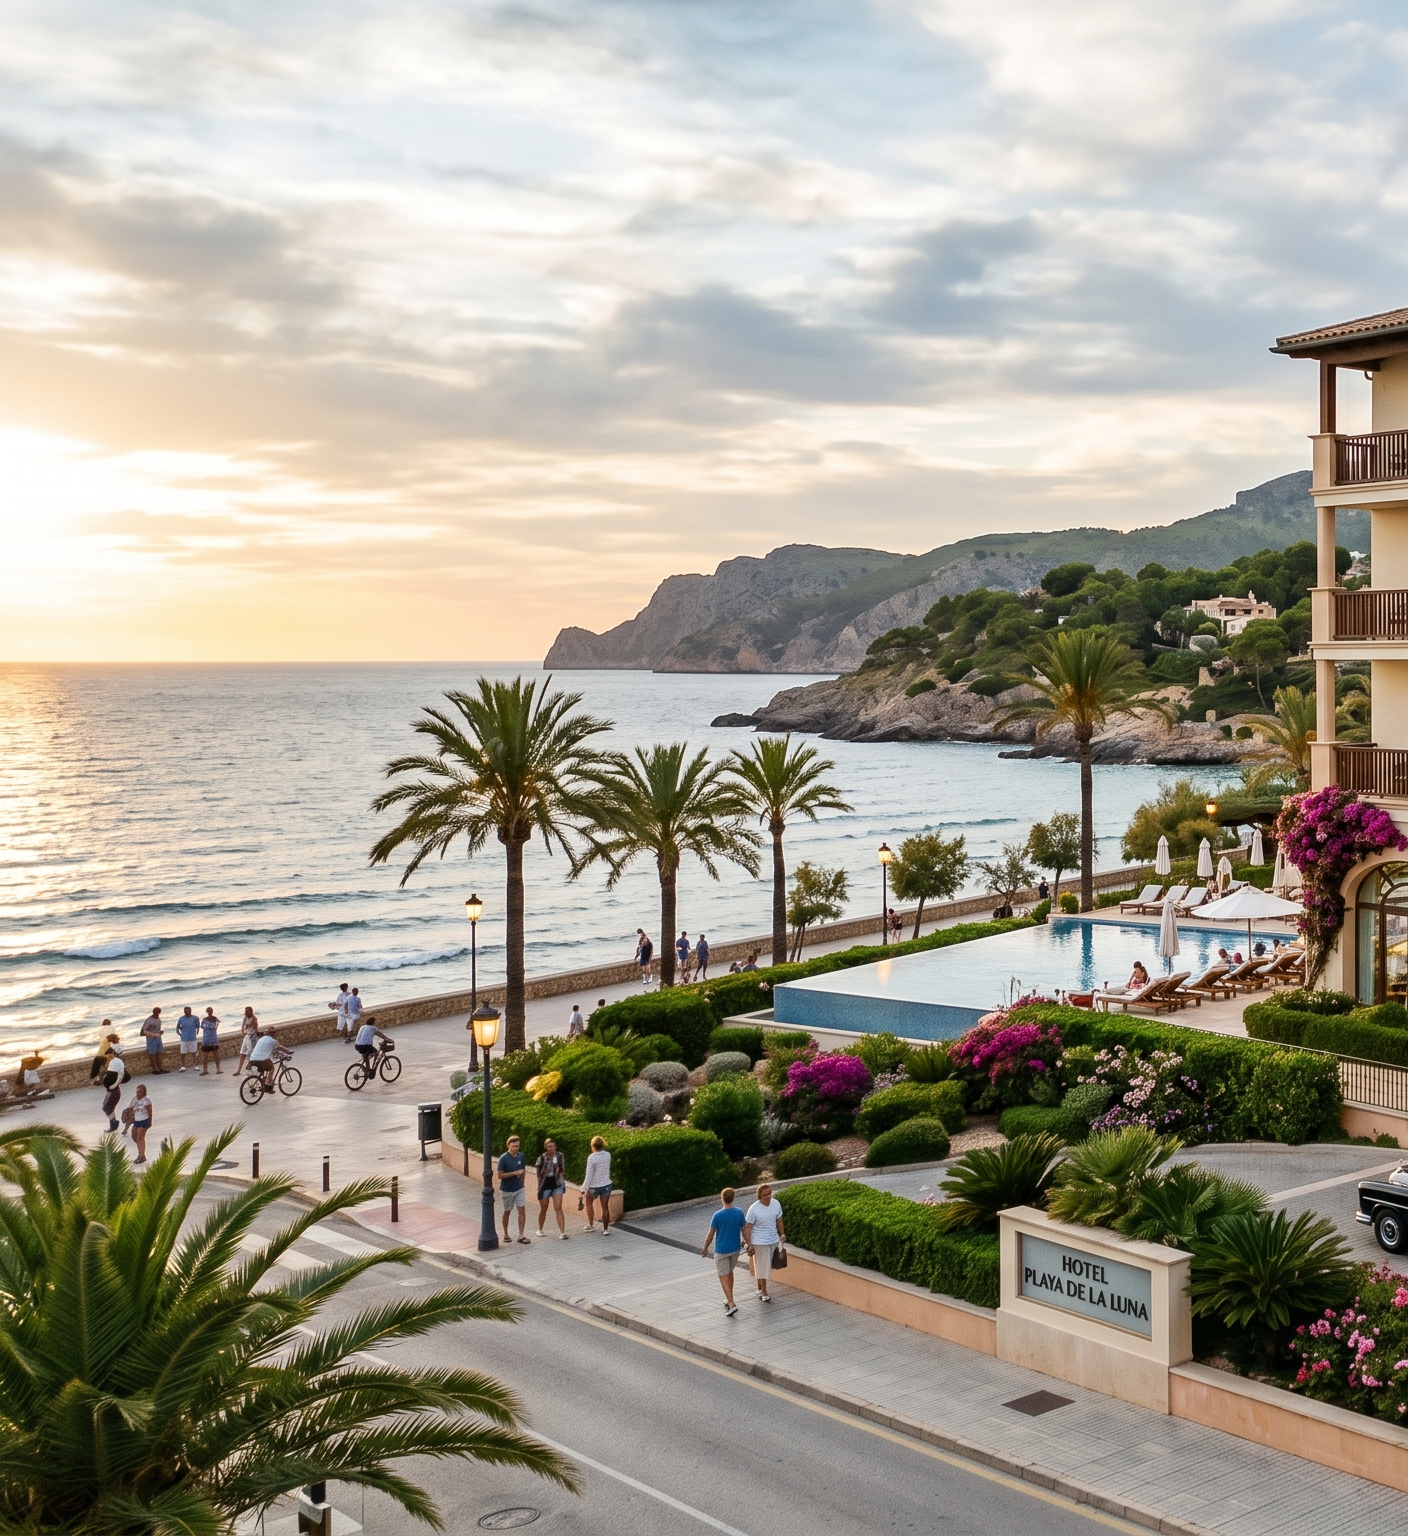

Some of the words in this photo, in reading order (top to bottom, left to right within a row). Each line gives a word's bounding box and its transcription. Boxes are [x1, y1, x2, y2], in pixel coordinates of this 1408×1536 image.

[1062, 1254, 1109, 1285] HOTEL
[1024, 1266, 1064, 1294] PLAYA
[1066, 1279, 1086, 1302] DE
[1089, 1286, 1107, 1308] LA
[1110, 1293, 1149, 1322] LUNA
